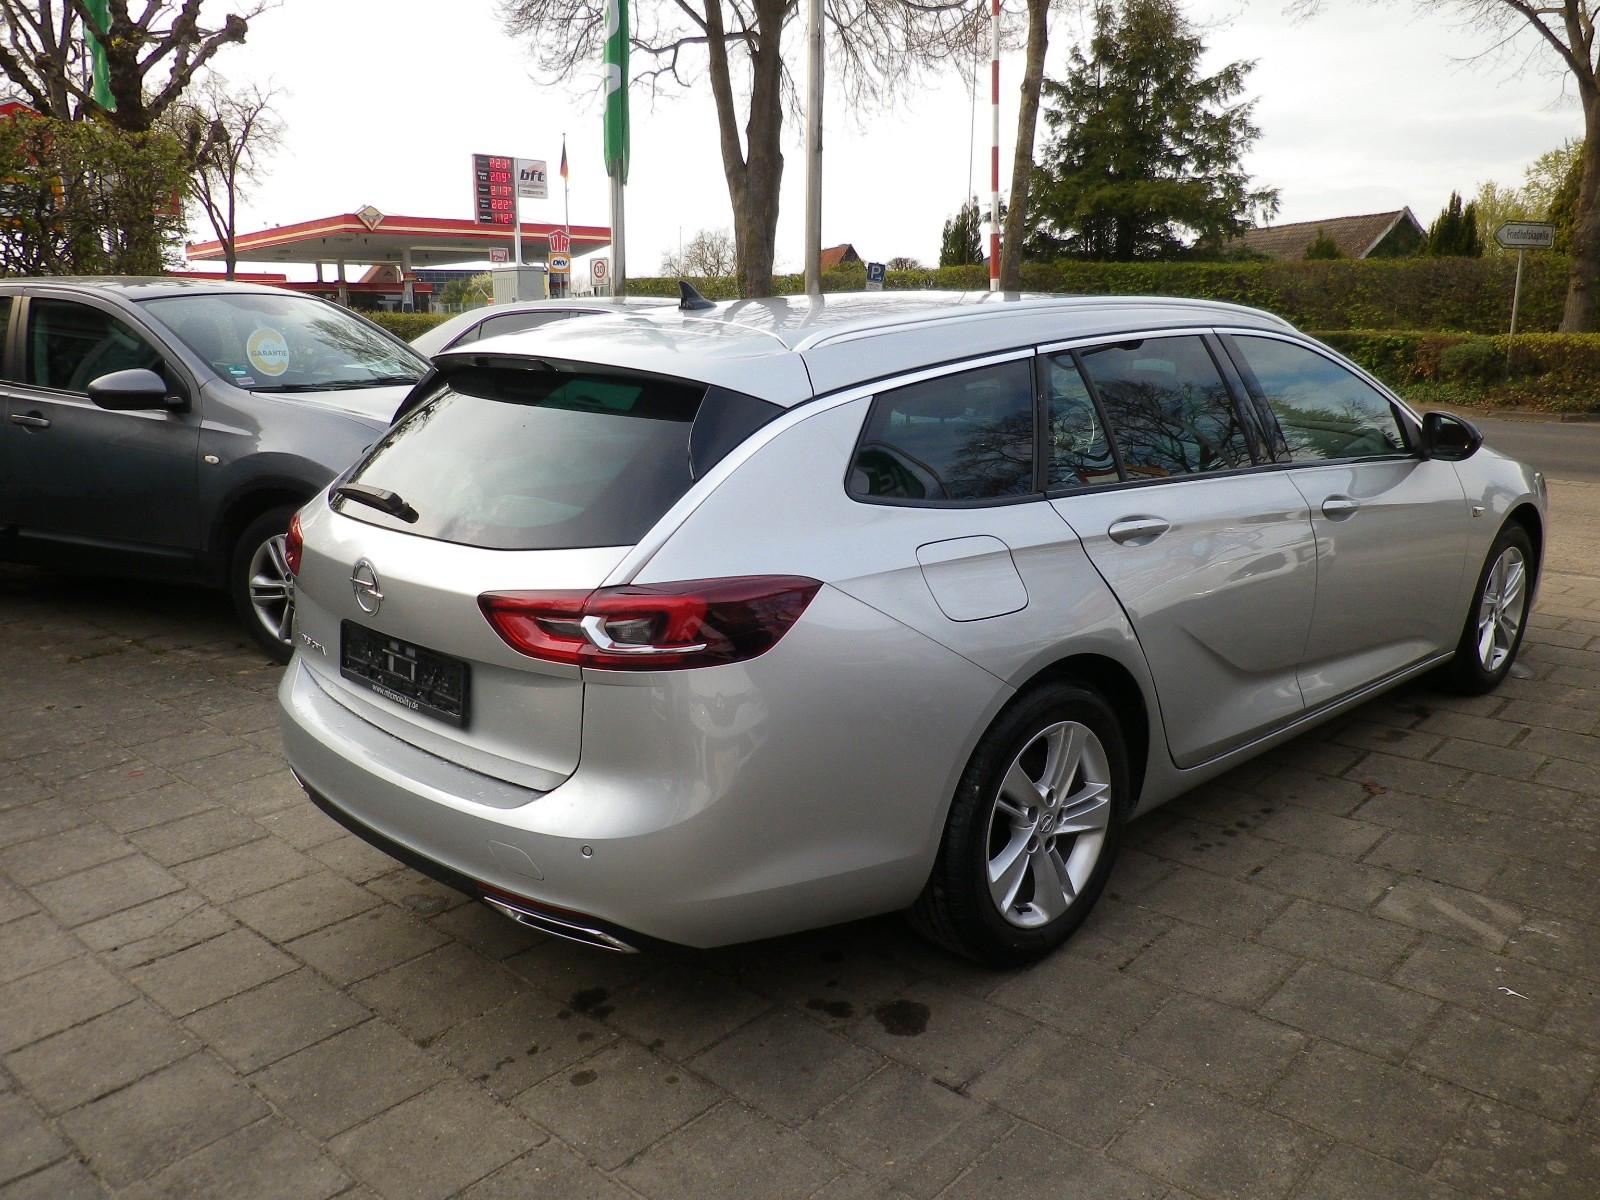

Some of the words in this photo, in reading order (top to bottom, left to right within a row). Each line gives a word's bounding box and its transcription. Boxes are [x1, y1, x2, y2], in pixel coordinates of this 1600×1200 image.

[520, 168, 545, 182] bft
[1506, 228, 1550, 242] Friedhofskapelle
[552, 259, 568, 267] DKV
[596, 265, 604, 274] 30
[870, 266, 881, 279] P
